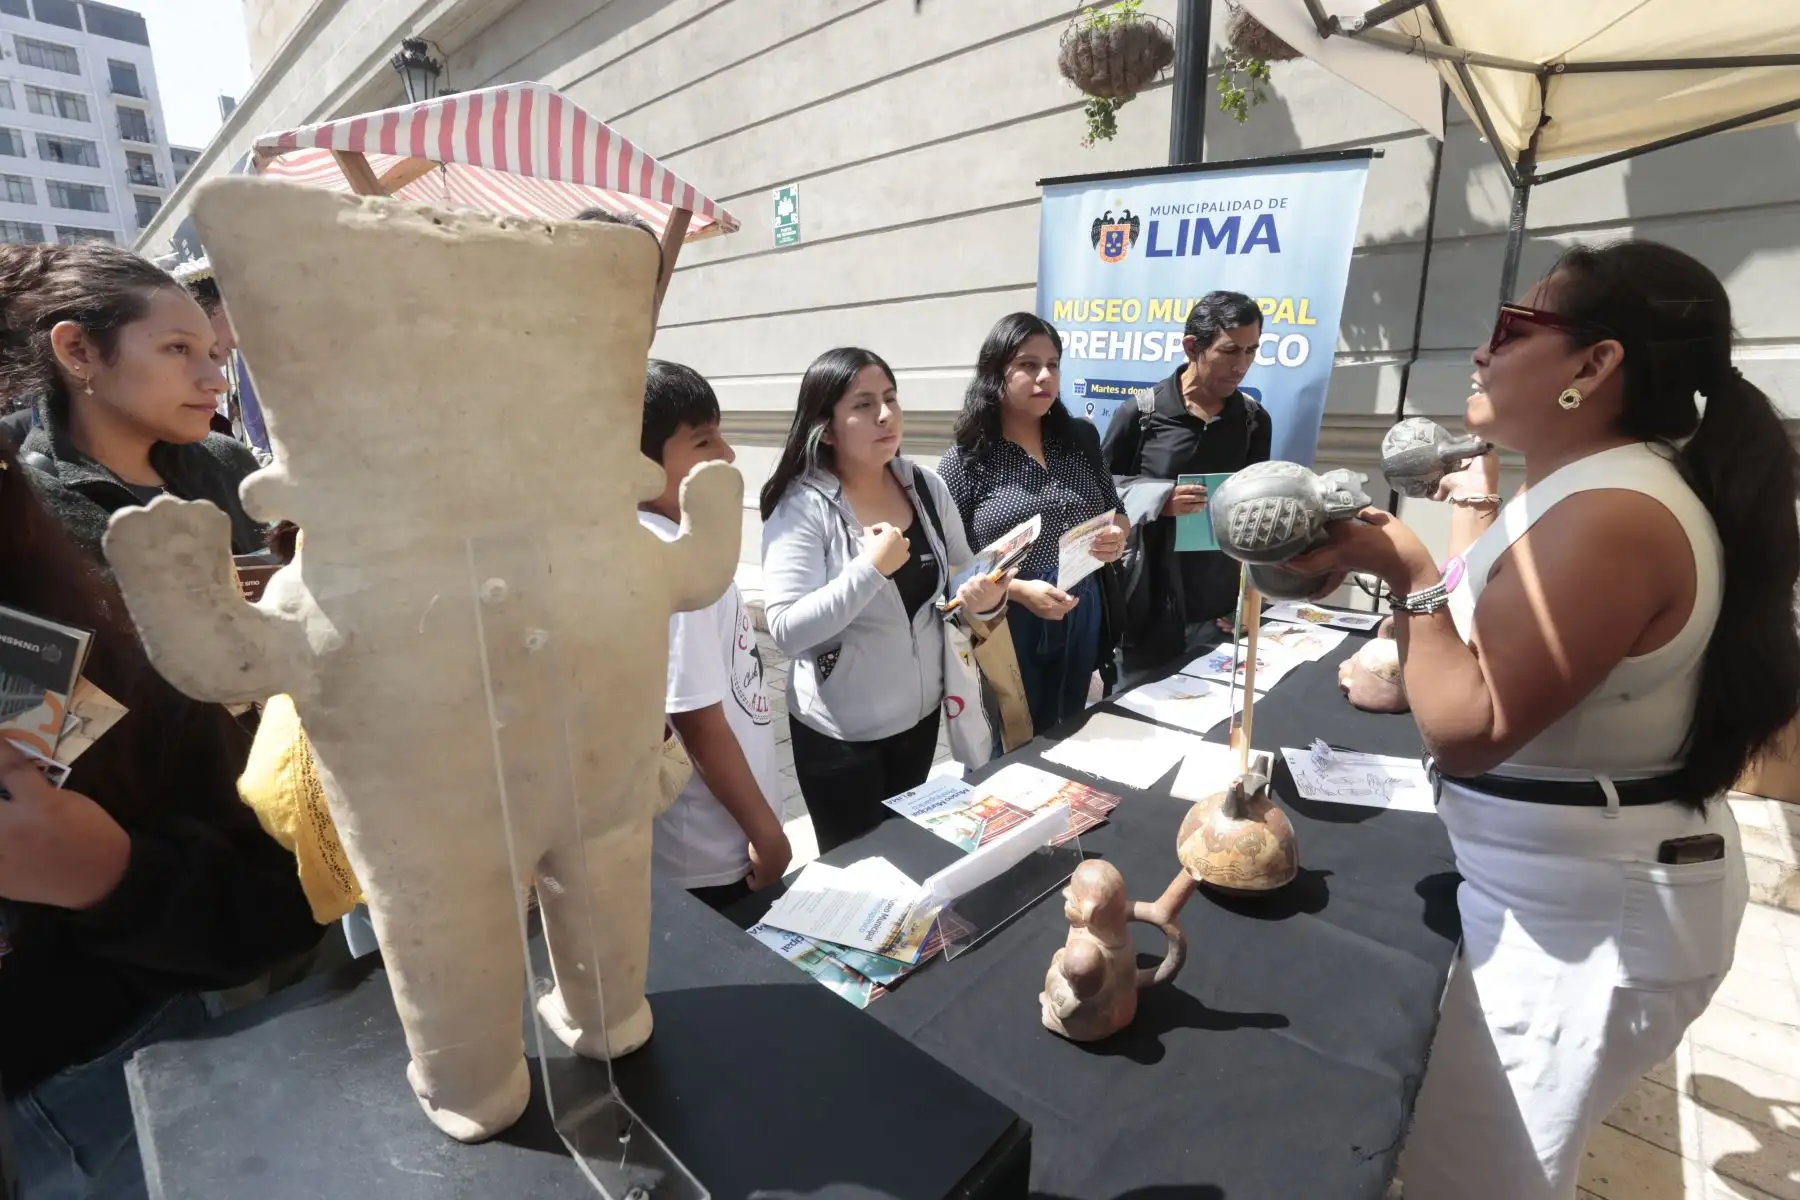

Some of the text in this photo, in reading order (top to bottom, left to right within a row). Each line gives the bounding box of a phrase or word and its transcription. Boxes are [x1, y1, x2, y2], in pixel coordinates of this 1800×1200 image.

[1149, 197, 1289, 217] MUNICIPALIDAD DE
[1145, 213, 1281, 258] LIMA
[1053, 297, 1317, 325] MUSEO MUPAL
[1057, 330, 1310, 367] PREHISPCO
[1091, 384, 1119, 394] Martes
[1121, 387, 1127, 395] a
[864, 898, 897, 942] useo Municipal
[780, 935, 805, 952] cipal
